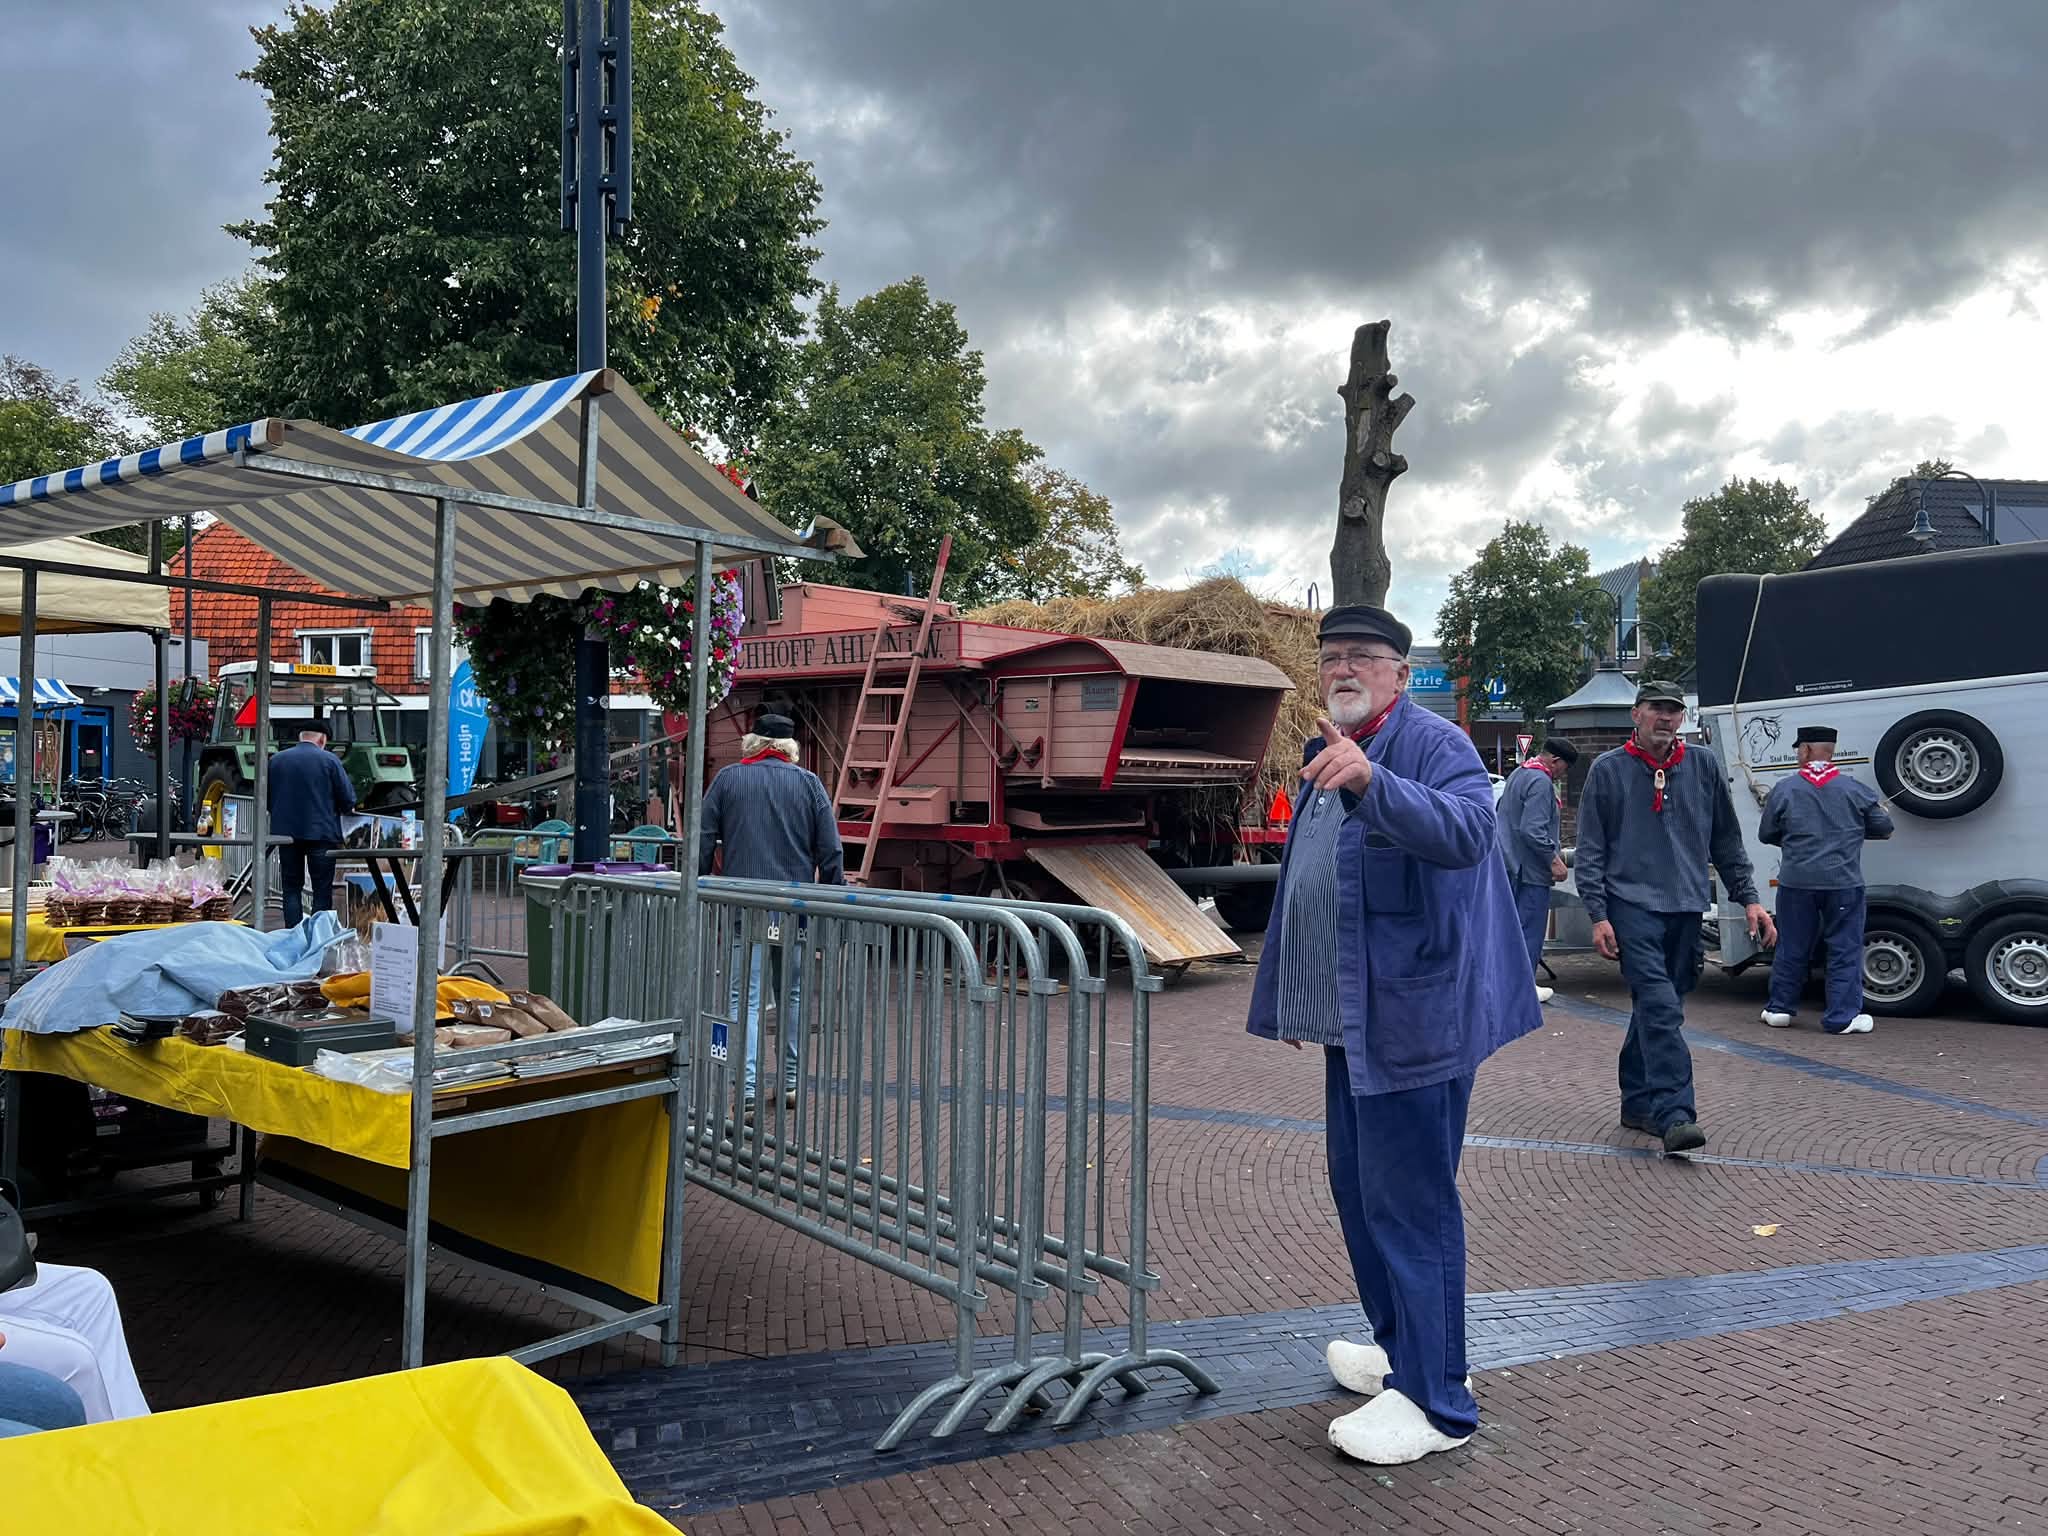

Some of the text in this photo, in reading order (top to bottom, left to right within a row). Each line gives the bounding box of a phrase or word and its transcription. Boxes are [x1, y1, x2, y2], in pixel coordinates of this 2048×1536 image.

[823, 631, 903, 666] AHLN
[458, 724, 472, 762] Heijn
[710, 1040, 728, 1061] ede
